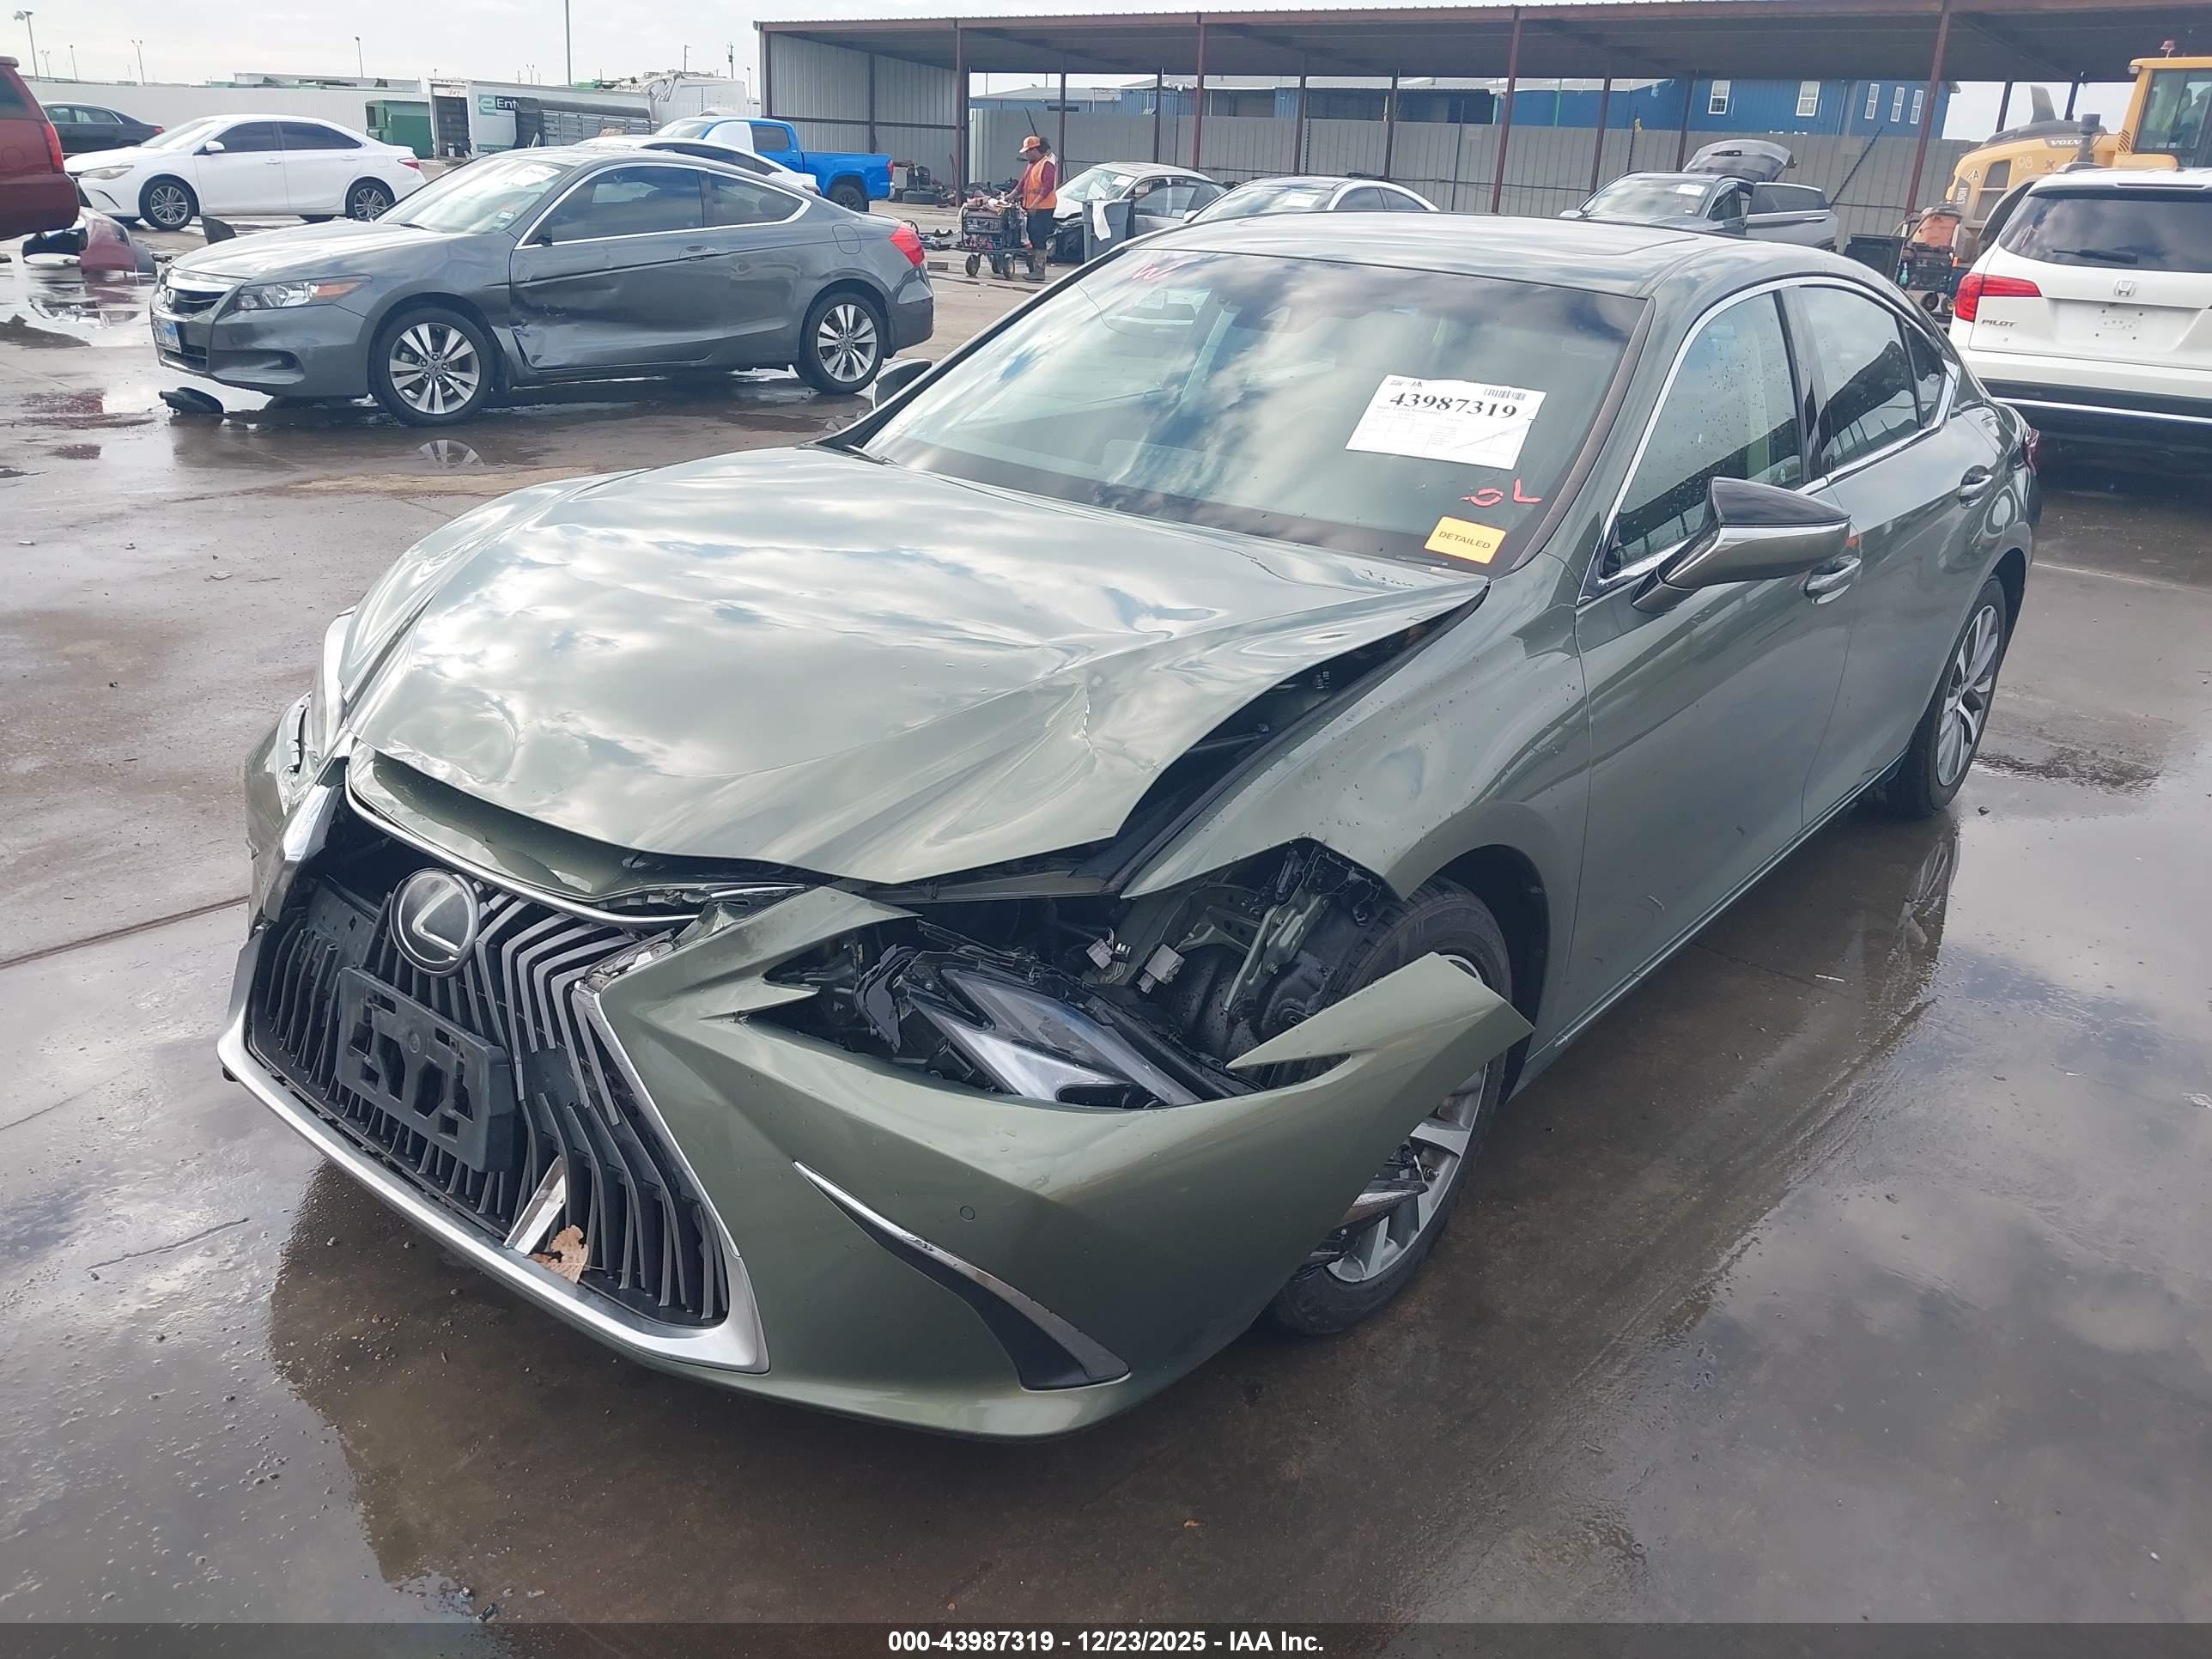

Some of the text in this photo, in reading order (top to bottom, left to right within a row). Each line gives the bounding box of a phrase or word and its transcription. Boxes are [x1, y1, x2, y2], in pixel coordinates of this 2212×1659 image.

[1982, 319, 2016, 327] PILOT
[1389, 392, 1517, 418] 43987319
[1438, 531, 1491, 549] DETAILED
